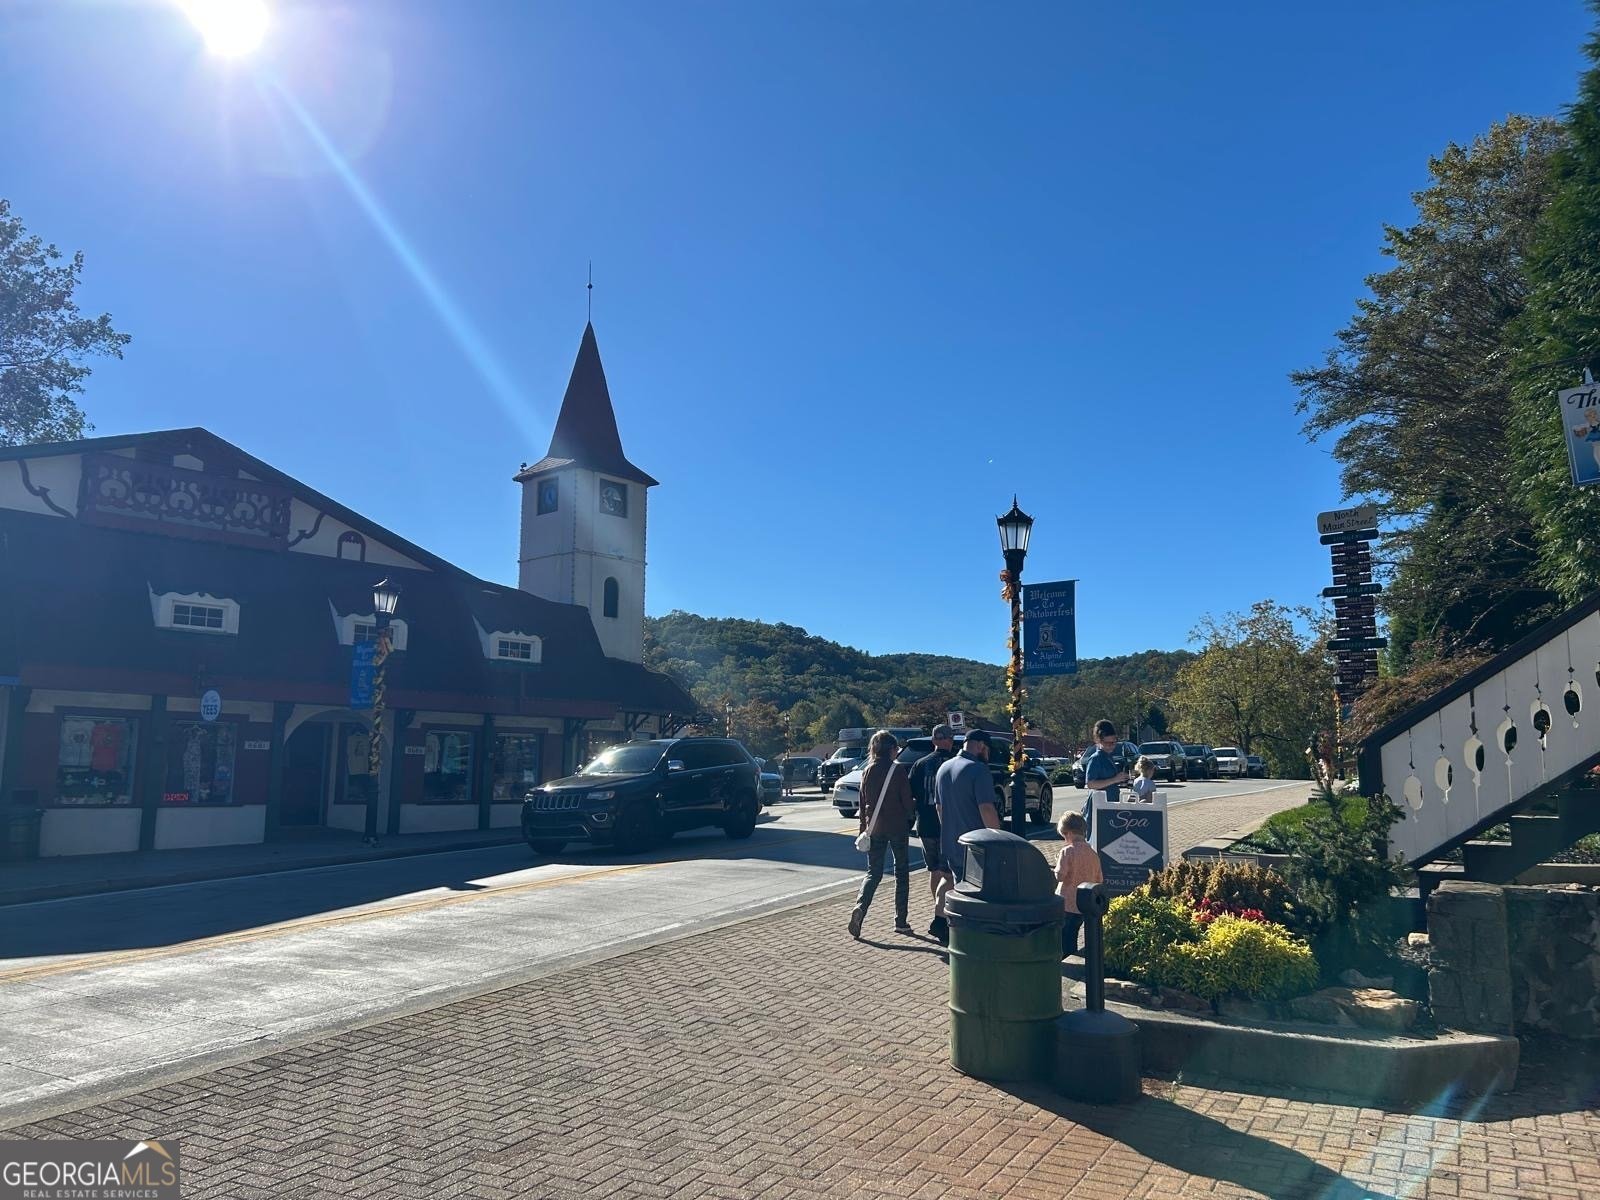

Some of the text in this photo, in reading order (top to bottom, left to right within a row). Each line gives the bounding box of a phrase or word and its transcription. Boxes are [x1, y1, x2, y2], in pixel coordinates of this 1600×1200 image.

[1567, 389, 1600, 408] Th
[1334, 510, 1359, 521] North
[1323, 516, 1374, 533] Main Street
[1030, 590, 1067, 600] Welcome
[1041, 599, 1054, 608] To
[1024, 607, 1073, 619] Oktoberfest
[203, 704, 218, 716] TEES
[1109, 811, 1150, 831] Spa
